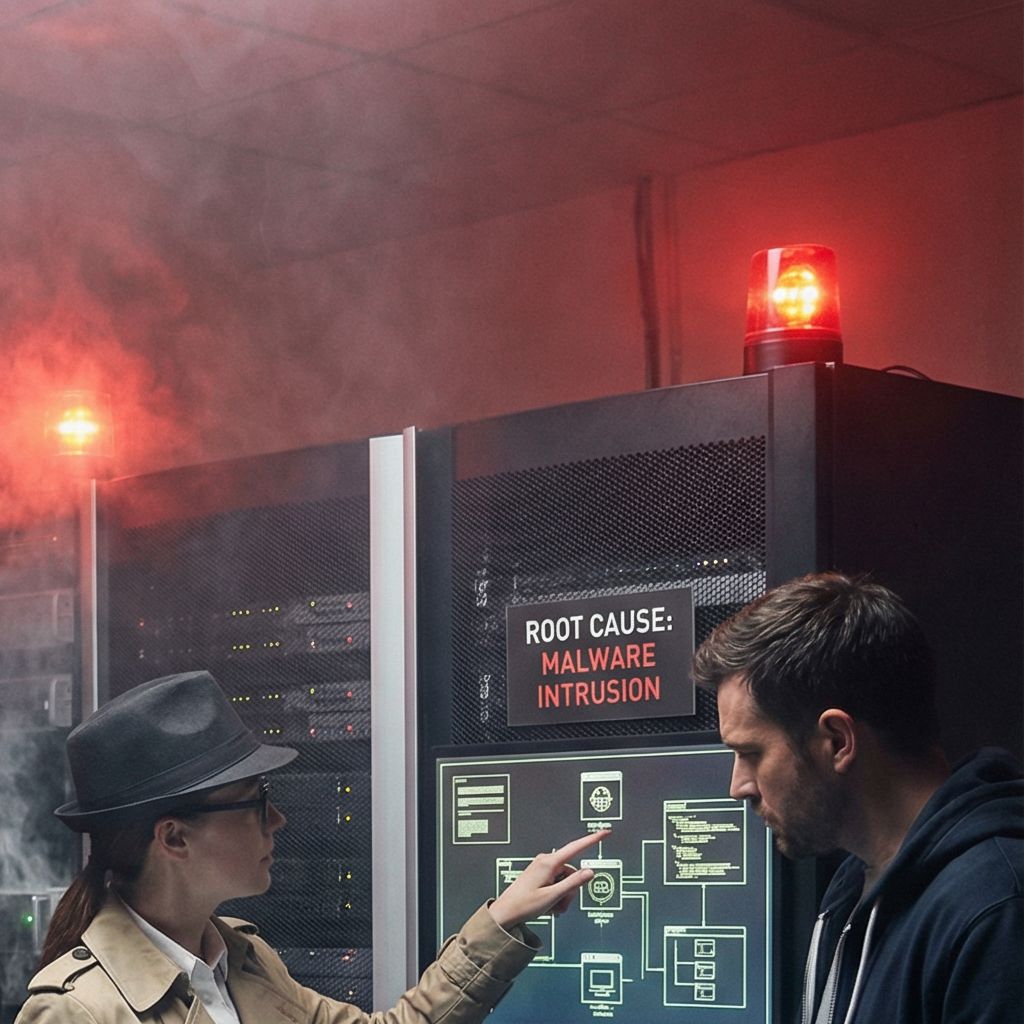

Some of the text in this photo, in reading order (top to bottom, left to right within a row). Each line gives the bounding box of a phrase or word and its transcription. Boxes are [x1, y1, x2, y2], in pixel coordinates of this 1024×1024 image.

[526, 606, 673, 645] ROOT CAUSE:
[541, 642, 656, 676] MALWARE
[538, 676, 660, 709] INTRUSION
